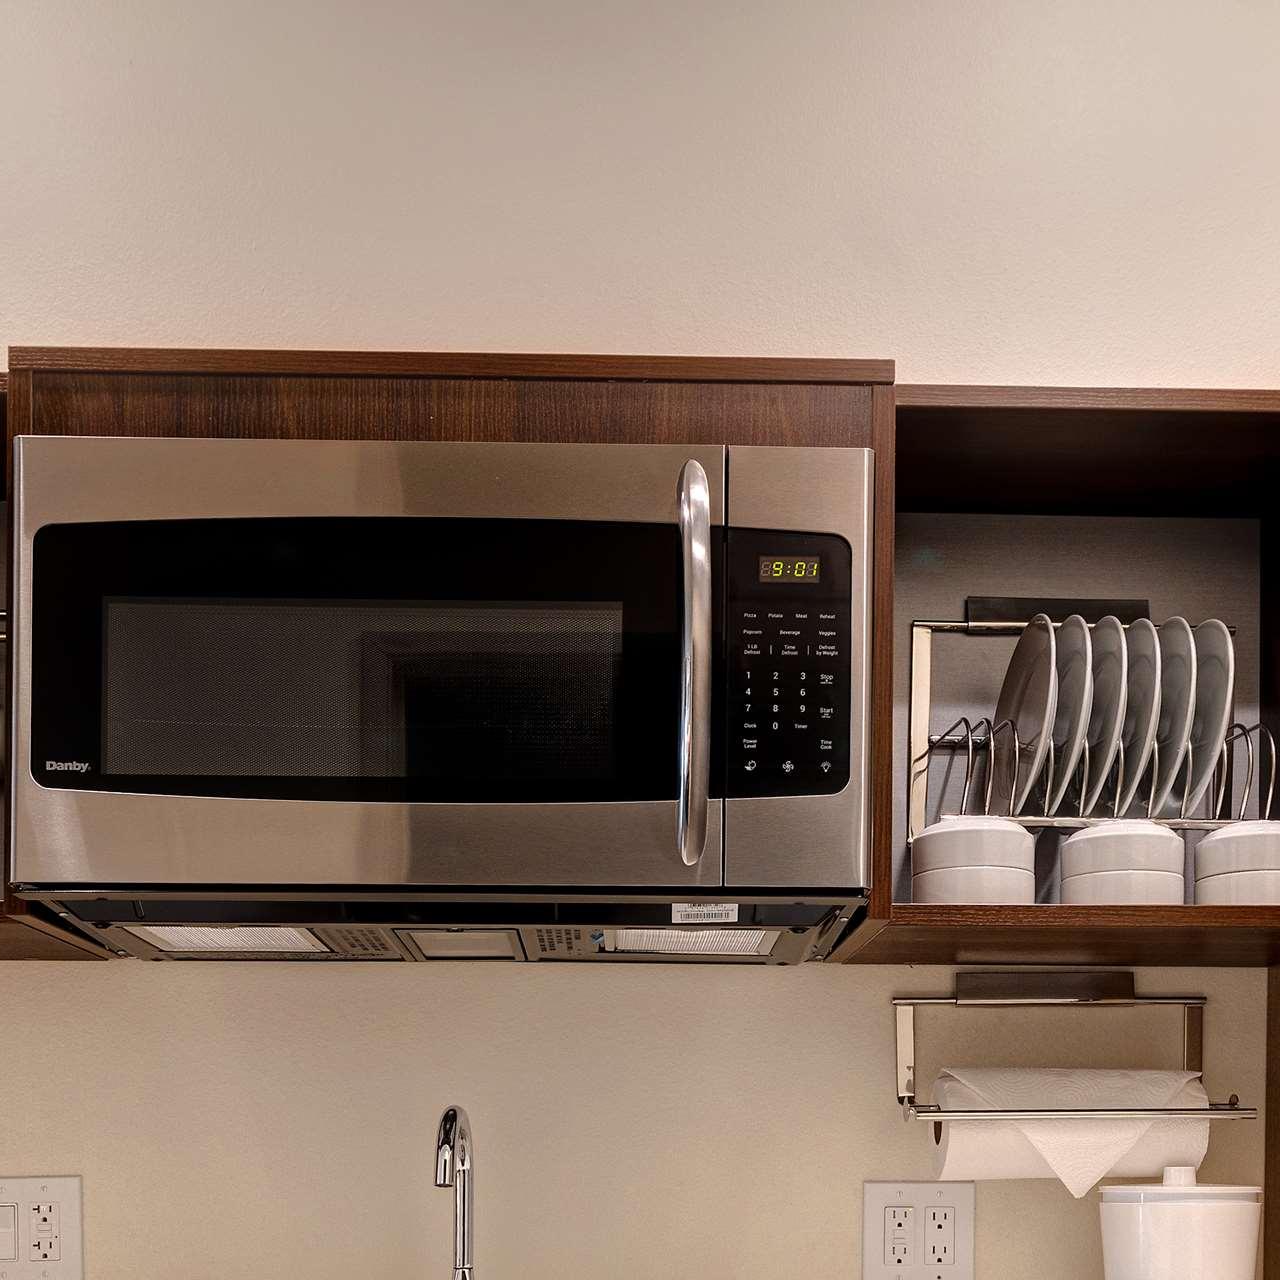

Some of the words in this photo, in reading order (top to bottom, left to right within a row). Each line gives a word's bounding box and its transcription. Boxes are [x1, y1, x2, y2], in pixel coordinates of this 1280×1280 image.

[773, 561, 817, 577] 9:01
[746, 671, 751, 679] 1
[773, 671, 779, 680] 2
[800, 672, 806, 680] 3
[745, 687, 751, 696] 4
[773, 687, 779, 696] 5
[800, 688, 806, 696] 6
[745, 704, 751, 712] 7
[772, 704, 779, 712] 8
[800, 704, 806, 713] 9
[772, 721, 779, 730] 0
[45, 760, 89, 773] Danby
